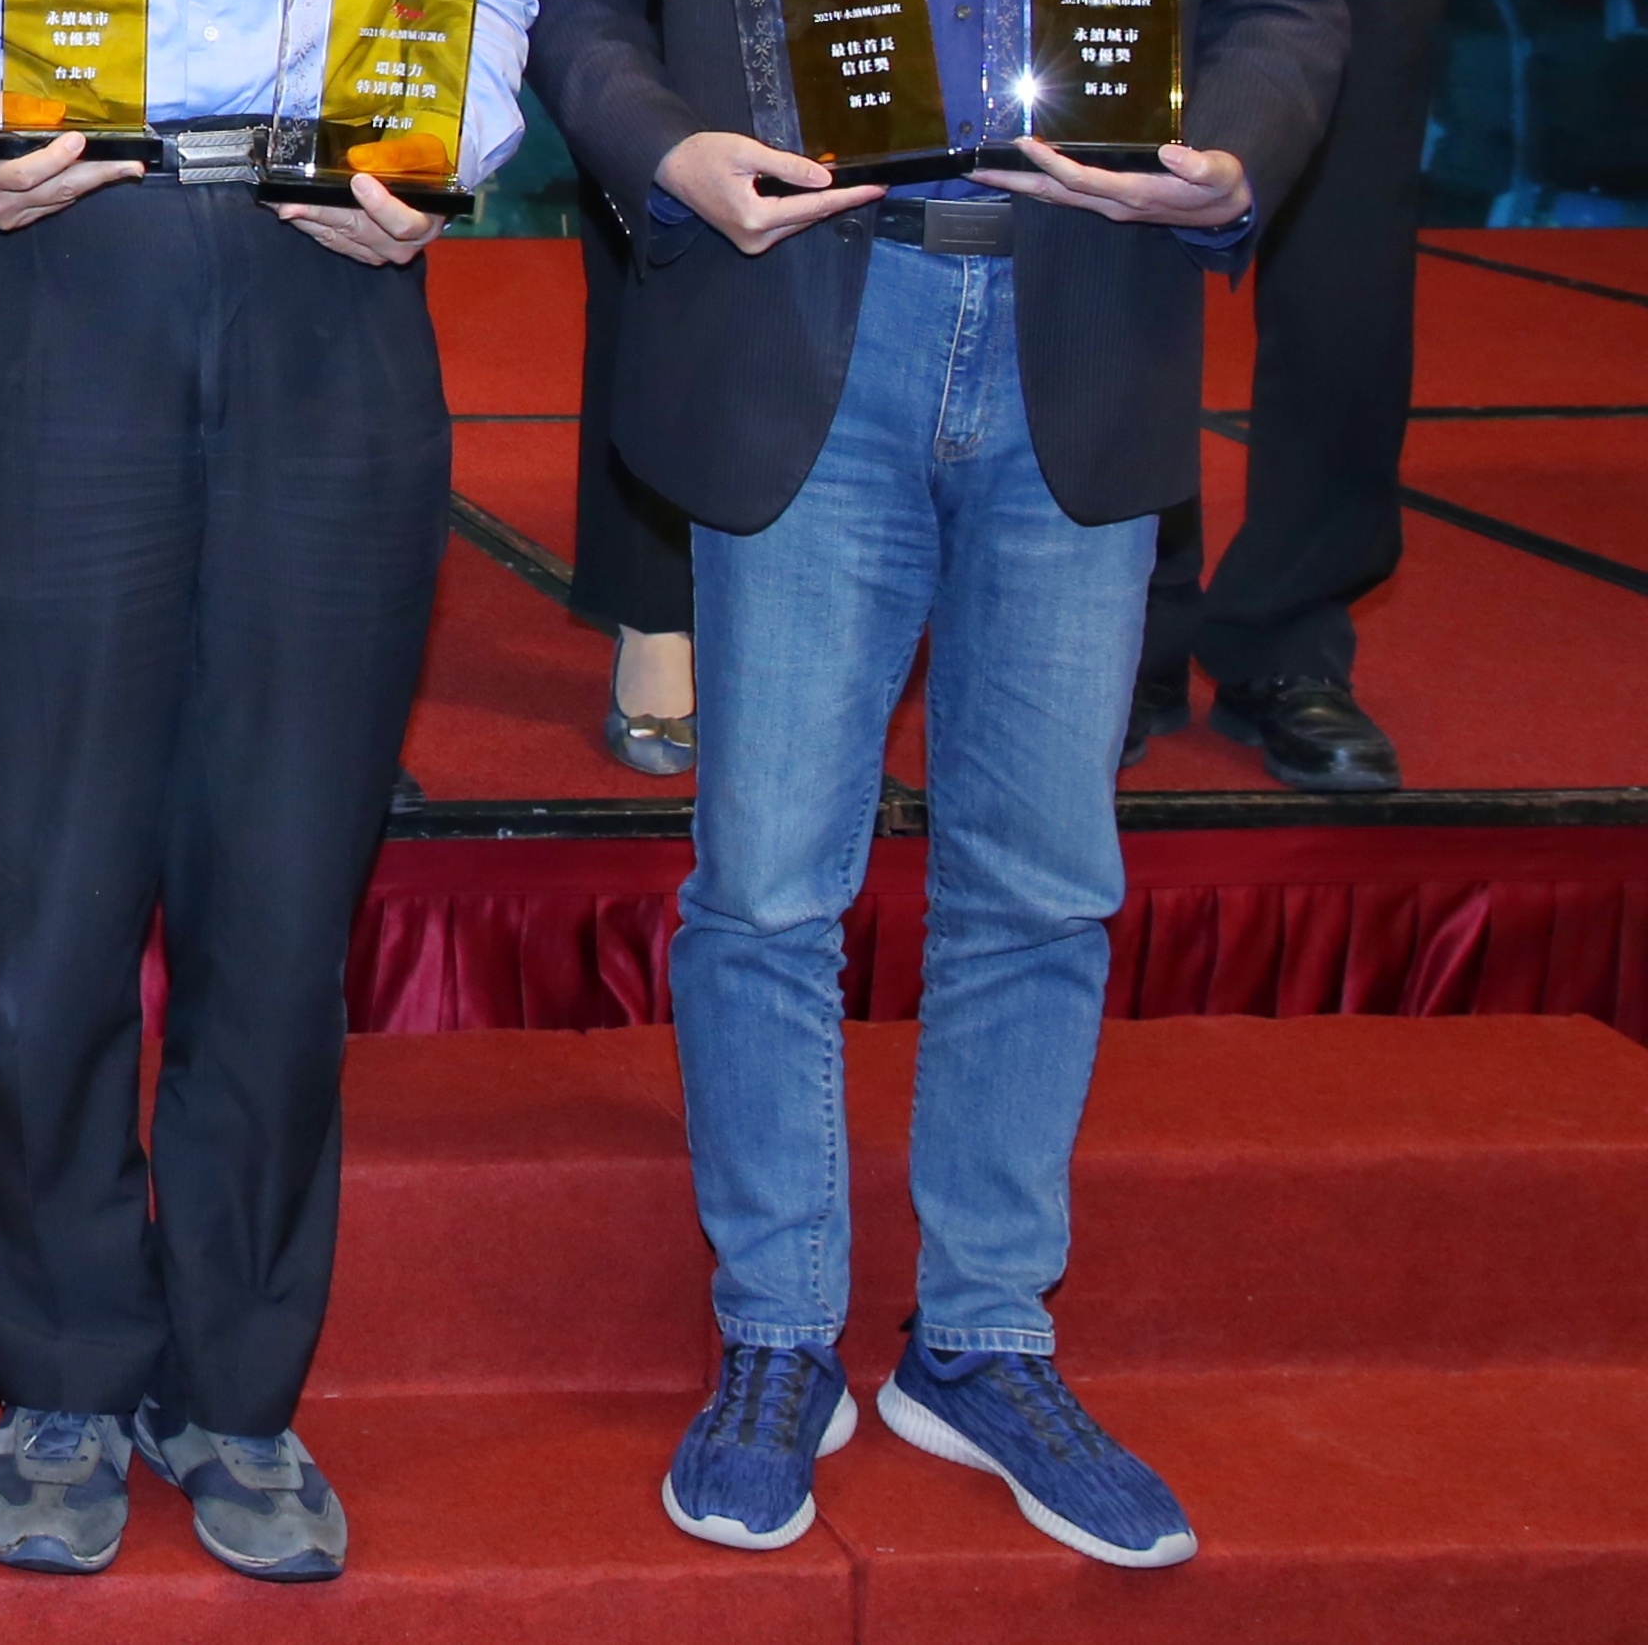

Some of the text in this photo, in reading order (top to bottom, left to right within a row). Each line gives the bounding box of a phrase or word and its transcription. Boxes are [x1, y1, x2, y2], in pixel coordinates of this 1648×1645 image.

[45, 11, 110, 27] 永續城市
[52, 31, 100, 46] 特優獎
[1072, 28, 1139, 43] 永續城市
[831, 37, 895, 58] 最佳首長
[1082, 47, 1131, 62] 特優獎
[55, 66, 97, 80] 台北市
[375, 61, 423, 77] 環境力
[841, 58, 890, 76] 信任獎
[356, 80, 437, 99] 特別傑出獎
[1084, 82, 1127, 96] 新北市
[849, 91, 891, 108] 新北市
[371, 114, 413, 129] 台北市
